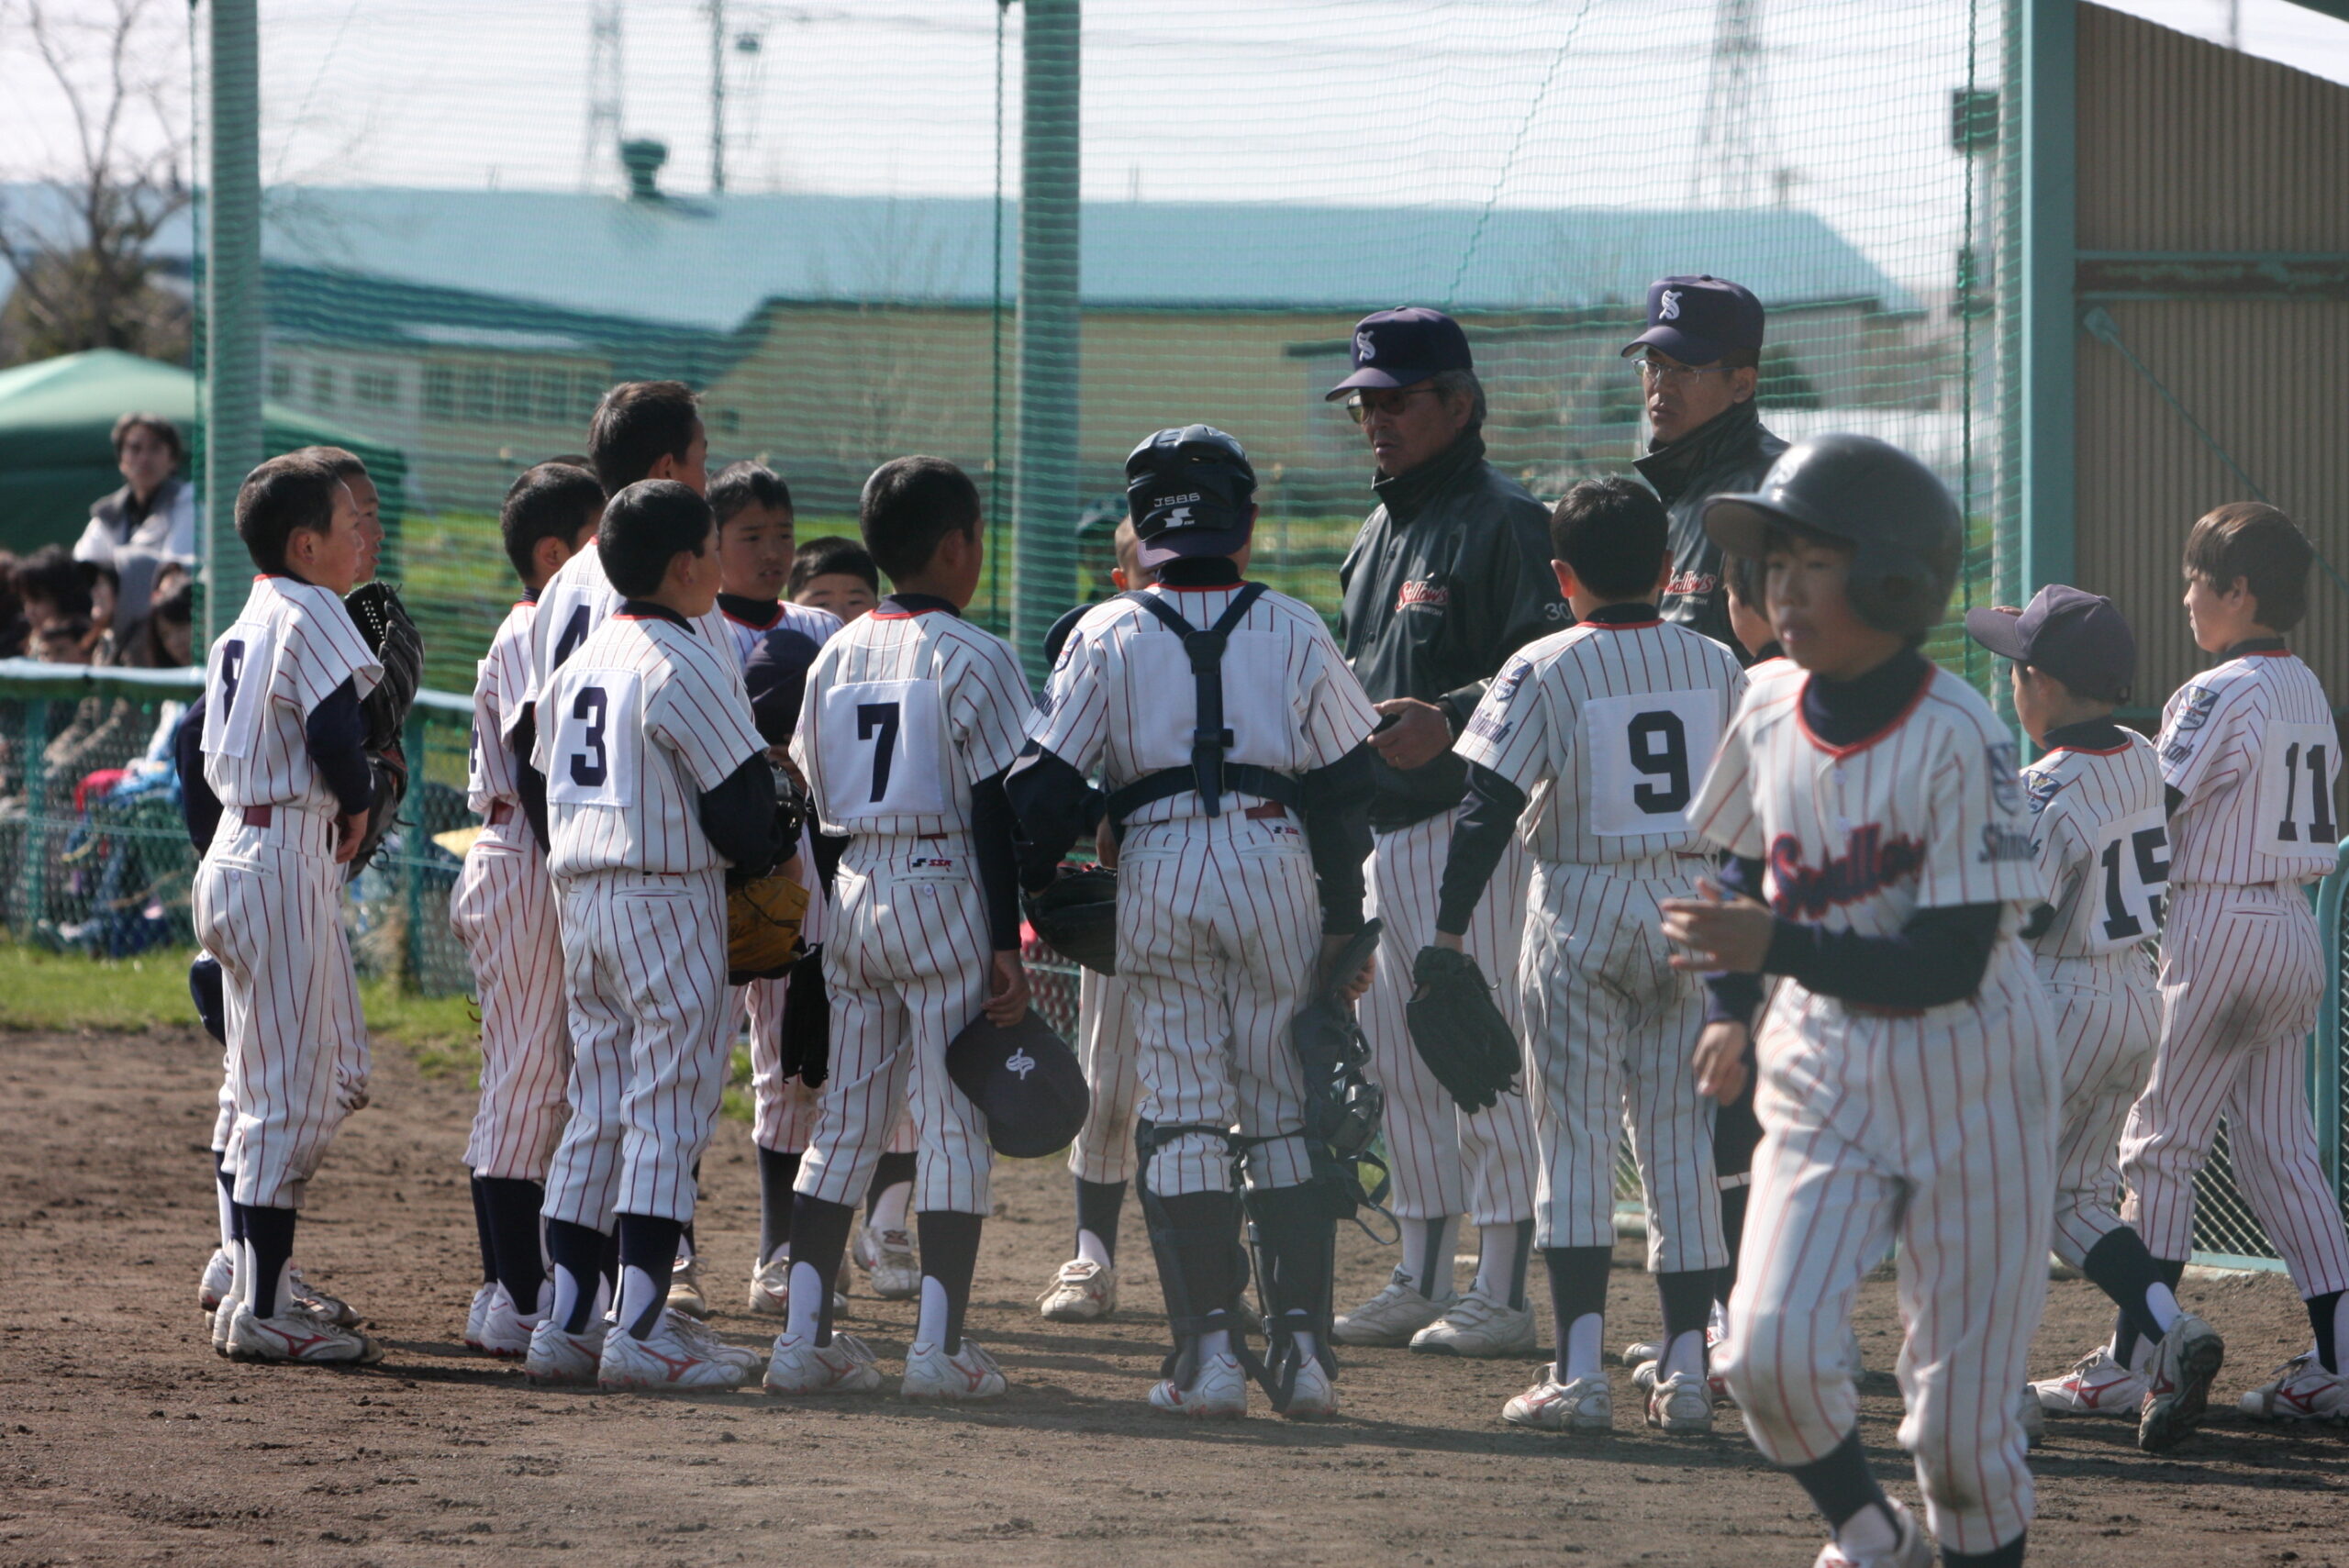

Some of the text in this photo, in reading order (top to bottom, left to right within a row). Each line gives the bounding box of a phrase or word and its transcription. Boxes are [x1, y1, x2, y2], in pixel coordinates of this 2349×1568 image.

[1544, 602, 1572, 621] 30
[570, 686, 607, 787] 3
[857, 702, 899, 803] 7
[1628, 710, 1690, 815] 9
[2277, 741, 2336, 844] 11
[2101, 827, 2169, 940] 15
